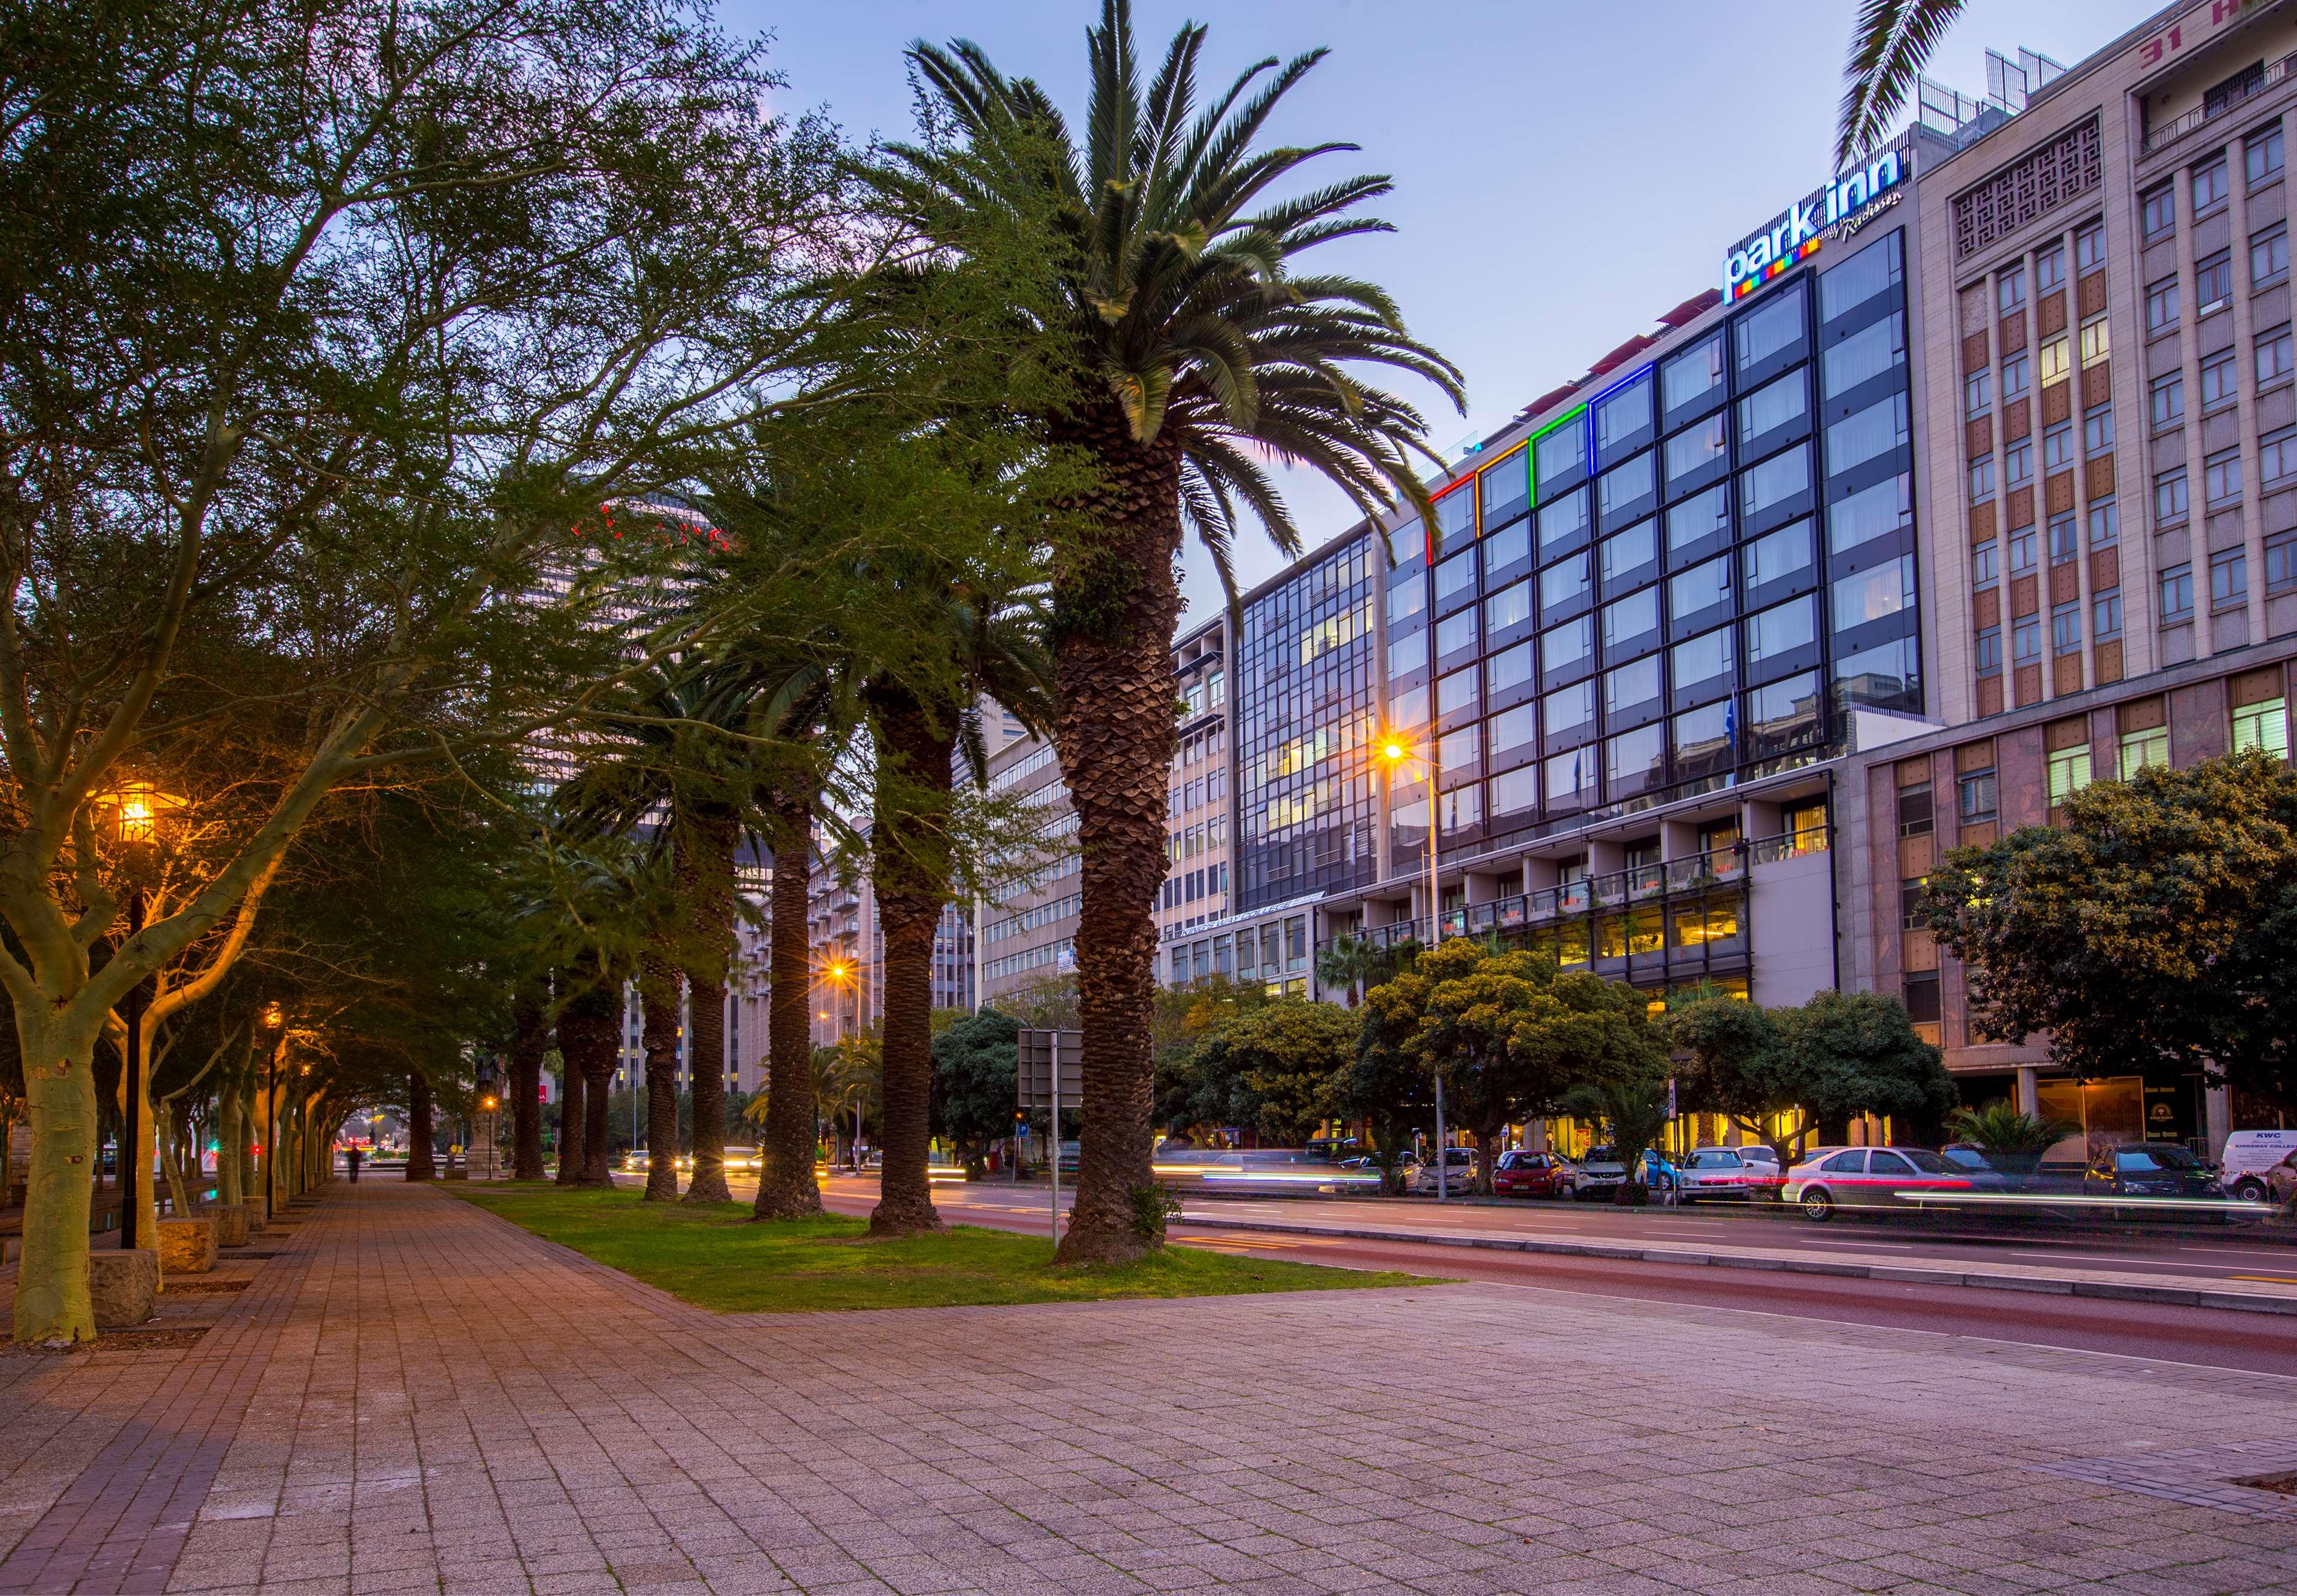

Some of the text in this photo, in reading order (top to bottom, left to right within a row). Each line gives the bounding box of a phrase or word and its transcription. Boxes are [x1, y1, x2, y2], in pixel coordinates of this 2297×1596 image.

[2140, 25, 2181, 70] 31
[1723, 151, 1902, 306] park inn
[1830, 192, 1903, 242] by Radisson
